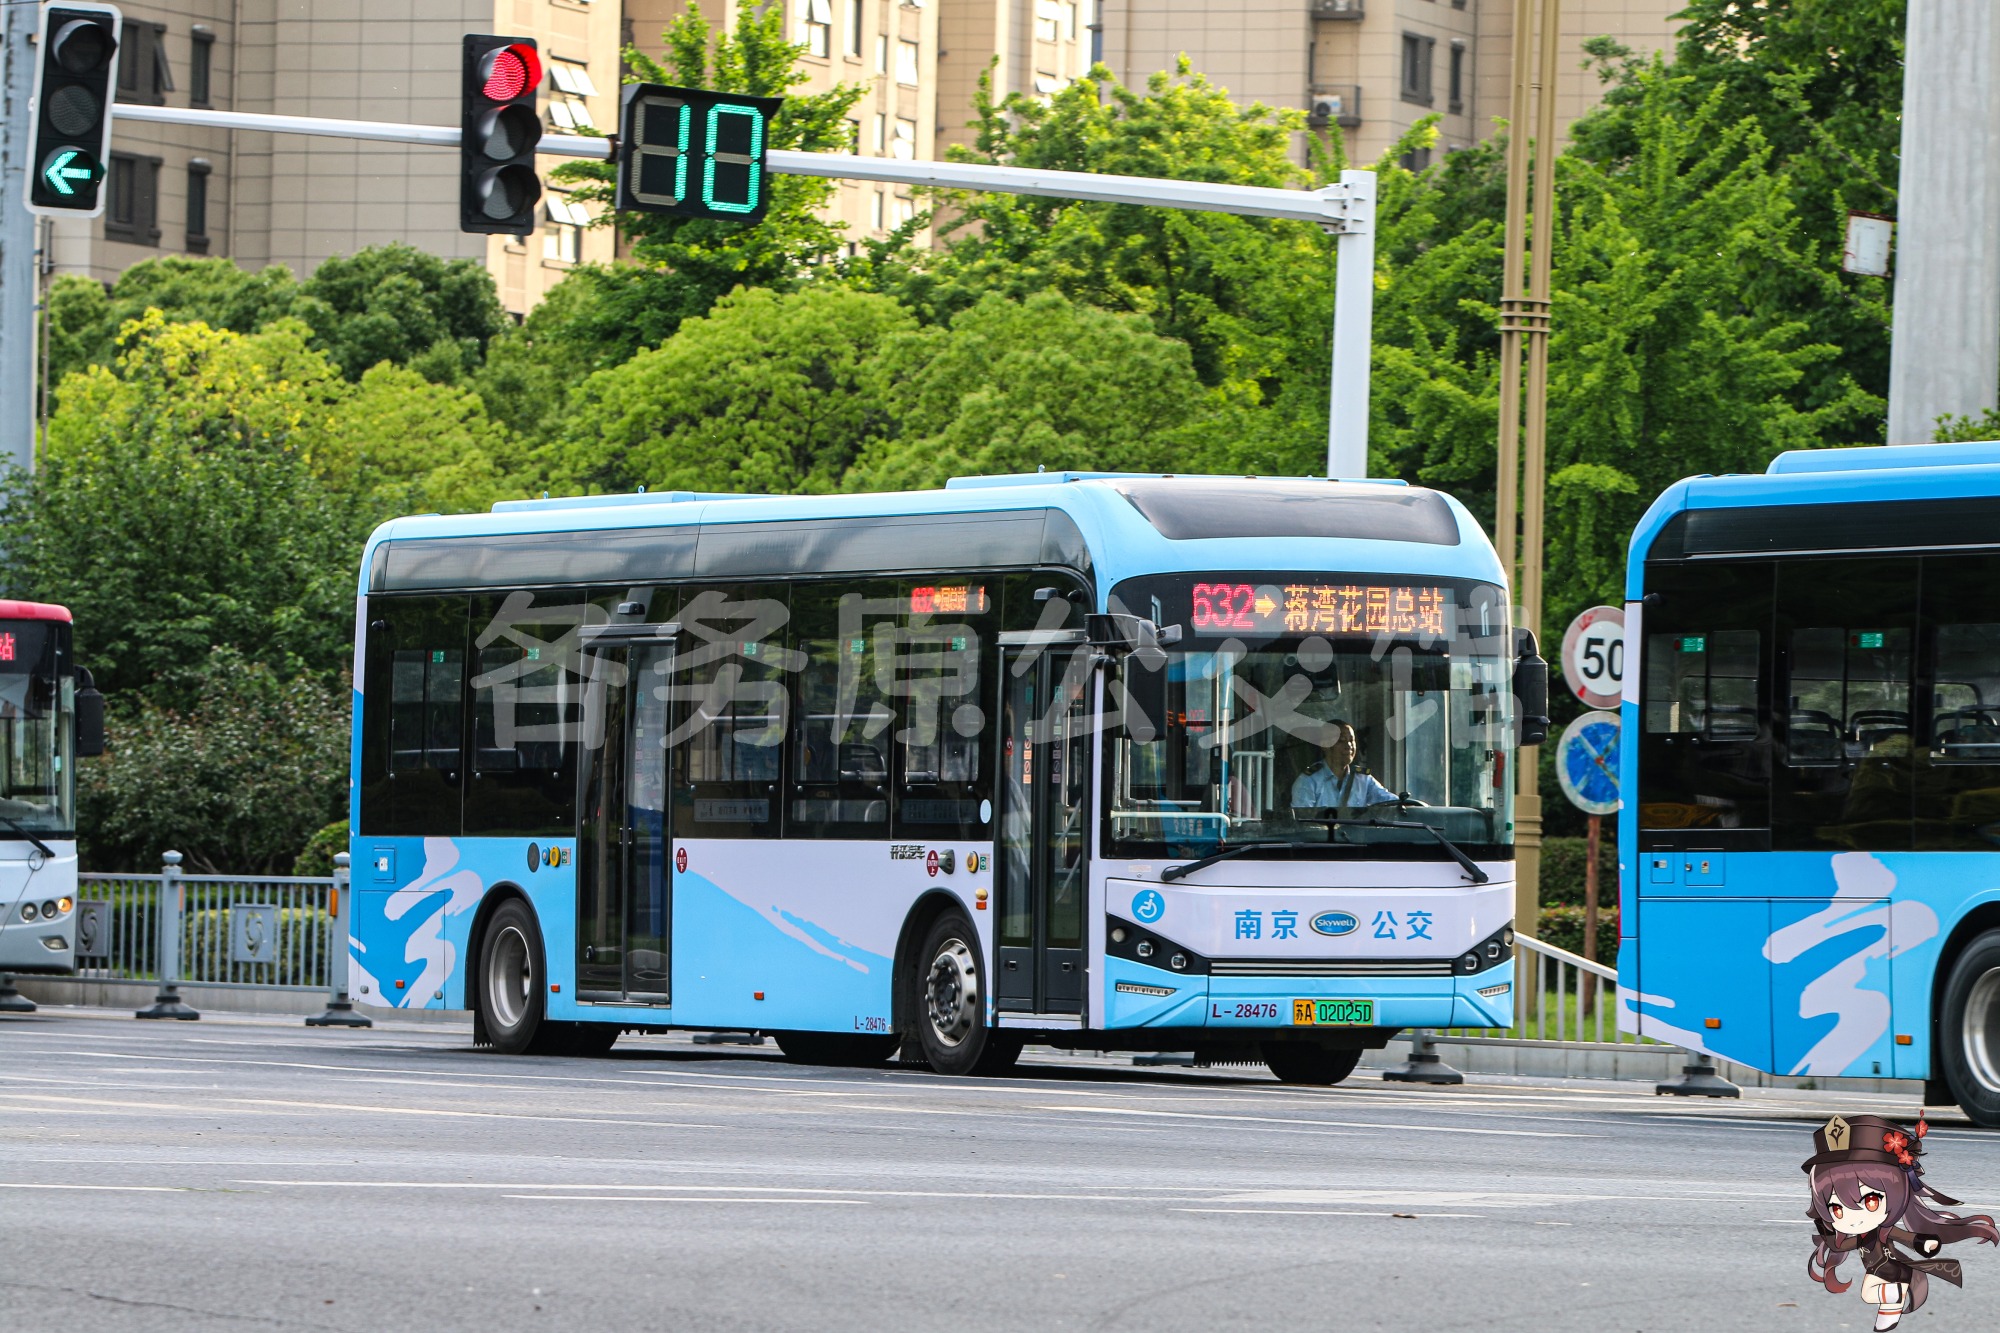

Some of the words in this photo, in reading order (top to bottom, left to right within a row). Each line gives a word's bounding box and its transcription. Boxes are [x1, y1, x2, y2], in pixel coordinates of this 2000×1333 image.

[674, 103, 764, 214] 10
[1192, 583, 1254, 627] 632
[1582, 637, 1623, 681] 50
[1234, 909, 1299, 940] 南京
[1371, 910, 1433, 941] 公交
[1316, 918, 1354, 928] Skywell
